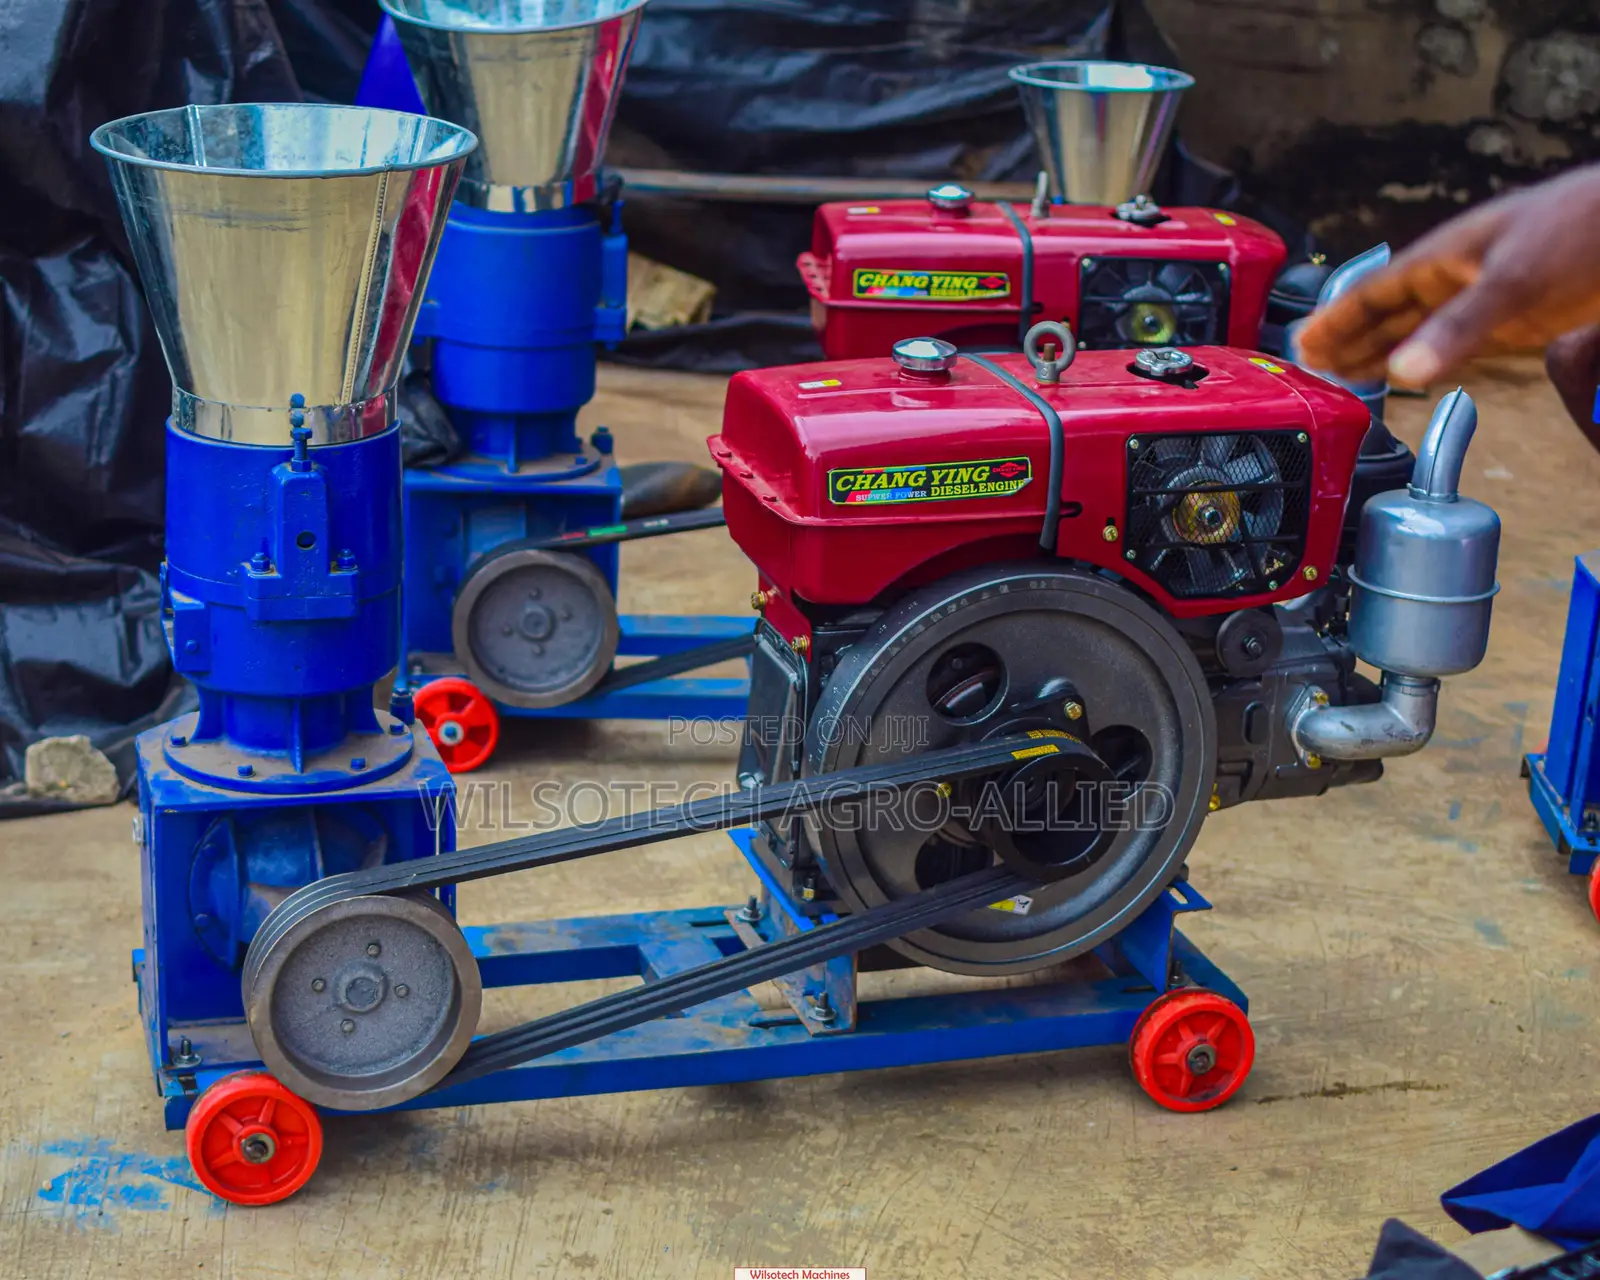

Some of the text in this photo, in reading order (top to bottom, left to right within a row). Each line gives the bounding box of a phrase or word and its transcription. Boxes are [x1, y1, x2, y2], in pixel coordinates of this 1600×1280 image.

[859, 273, 978, 289] CHANG YING
[836, 470, 927, 491] CHANG
[930, 465, 991, 486] YING
[855, 490, 928, 502] SUPWER POWER
